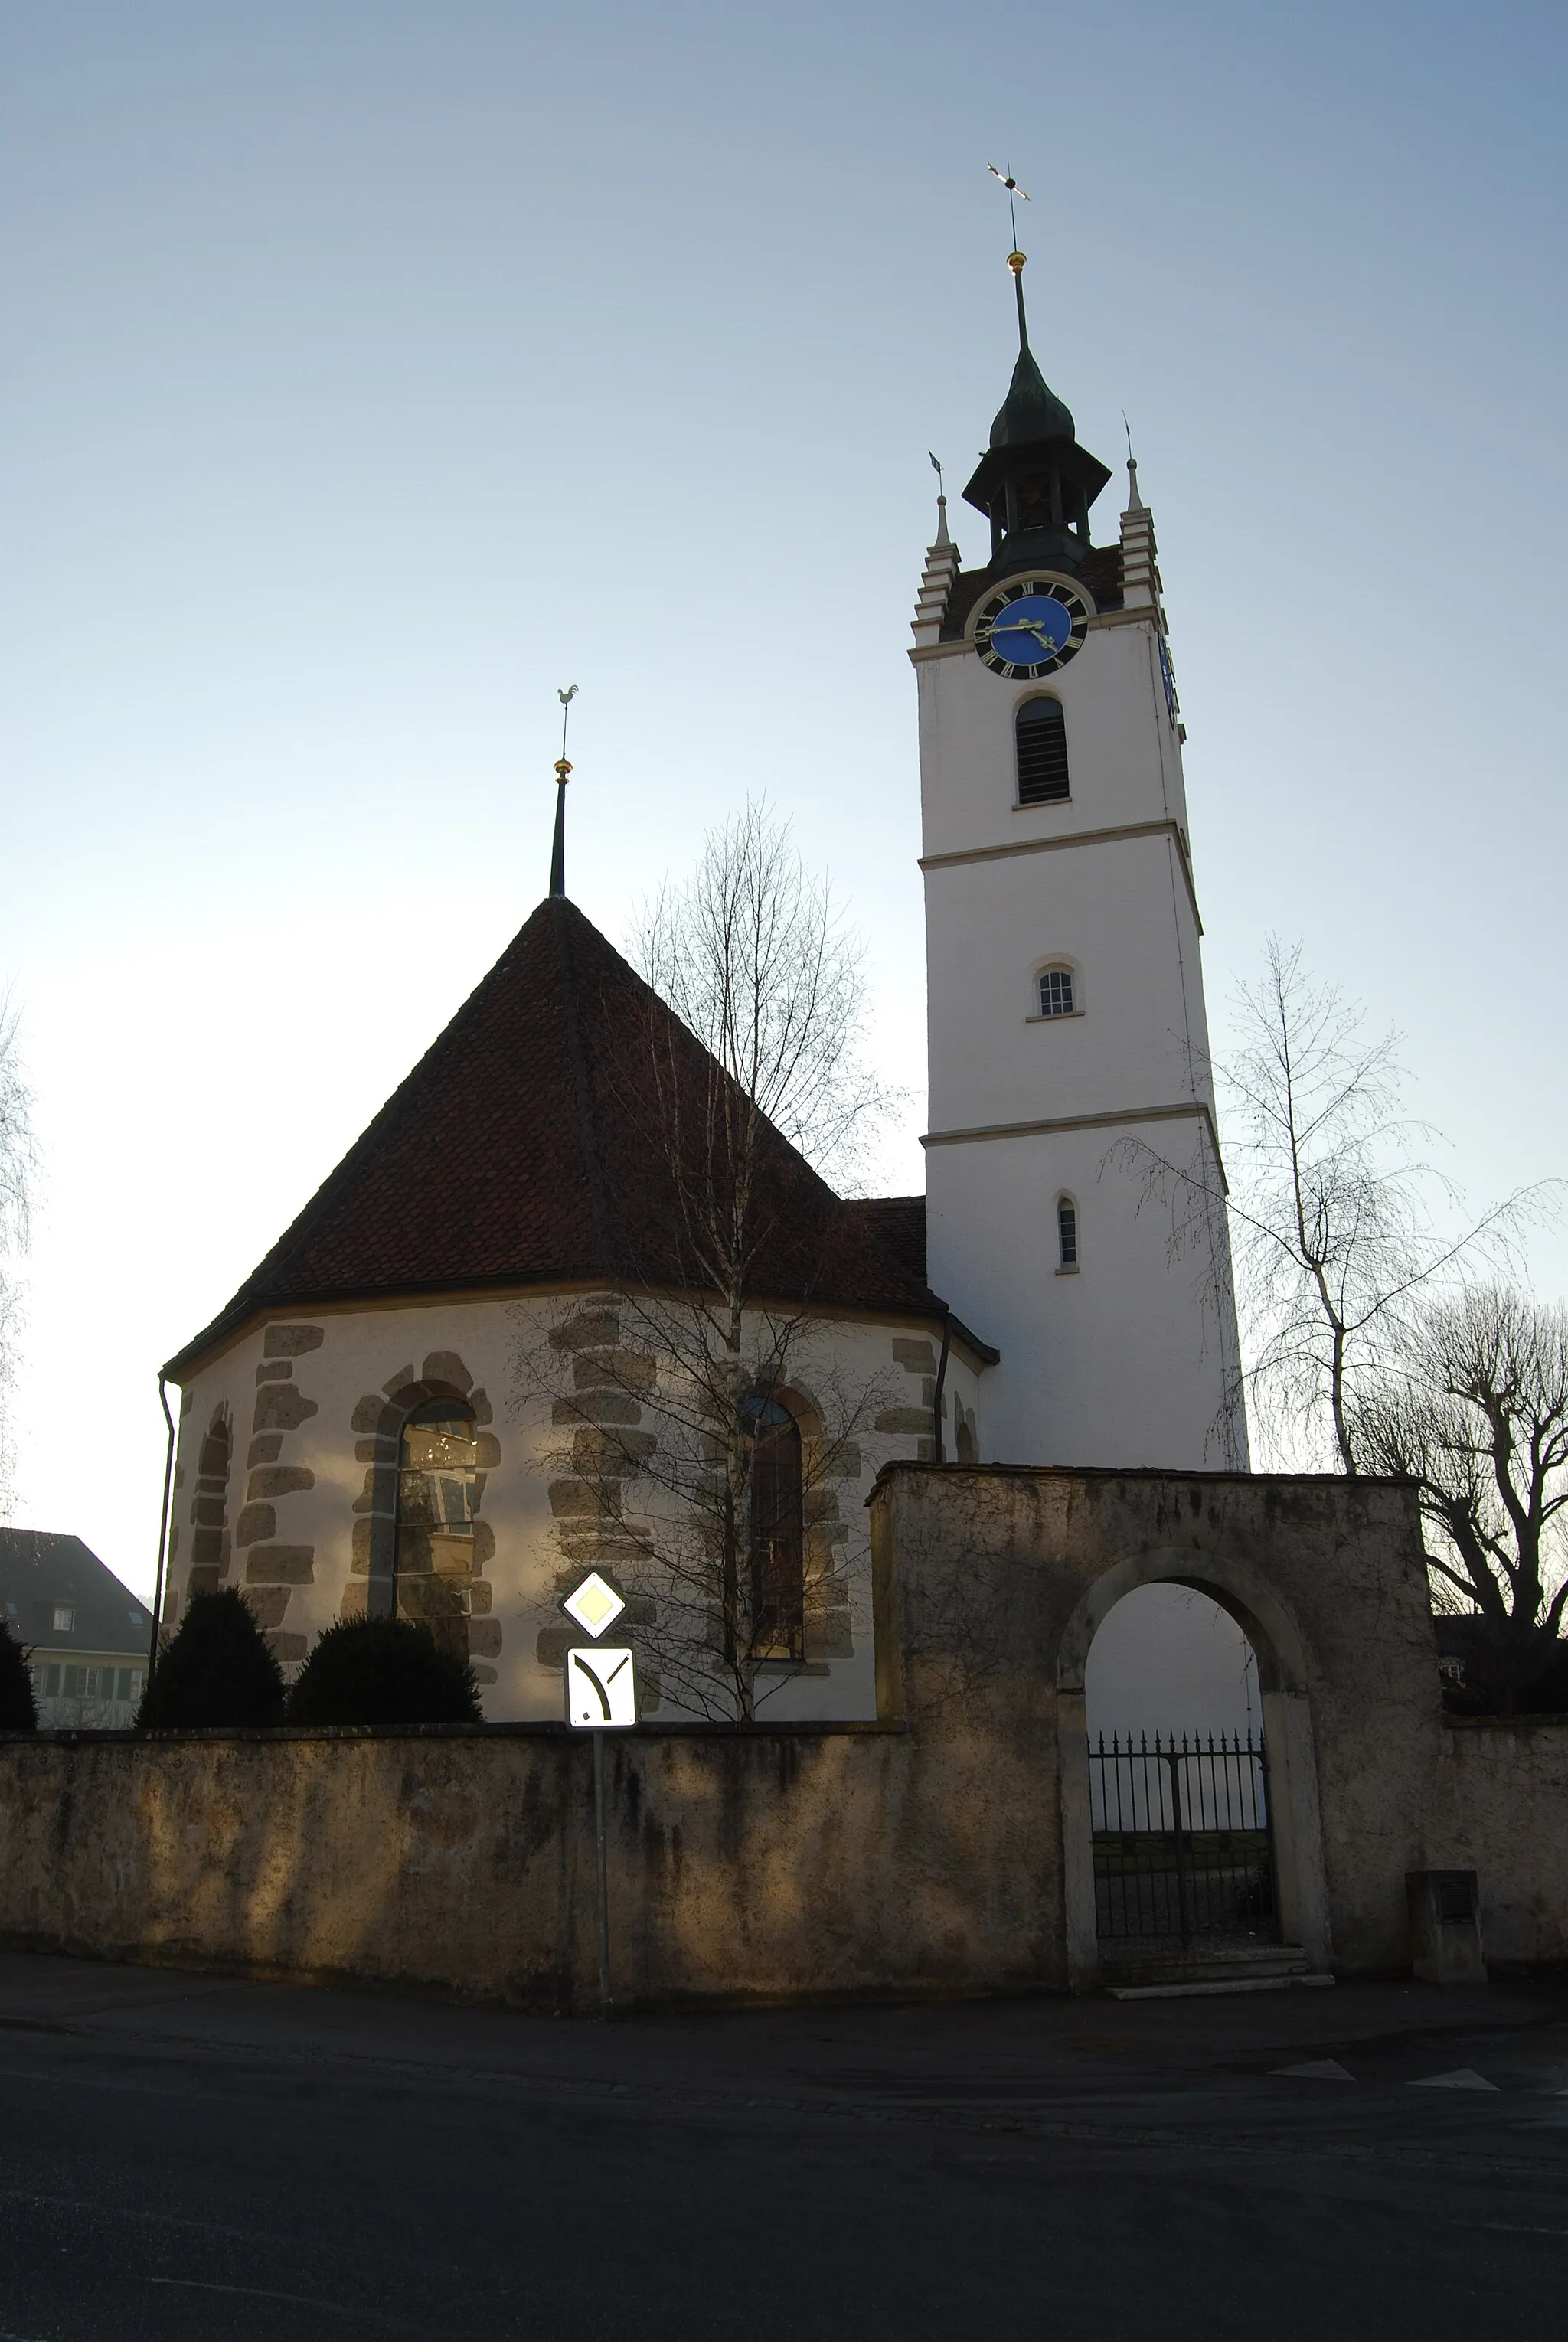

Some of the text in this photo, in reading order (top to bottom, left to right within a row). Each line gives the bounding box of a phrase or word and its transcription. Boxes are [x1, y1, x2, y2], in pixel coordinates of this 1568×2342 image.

[1021, 582, 1034, 596] XII
[1047, 583, 1057, 596] I
[1064, 596, 1079, 607] II
[1072, 616, 1087, 626] III
[981, 649, 998, 666] VIII
[1054, 656, 1063, 668] V
[1001, 662, 1015, 678] VII
[1028, 665, 1039, 678] VI
